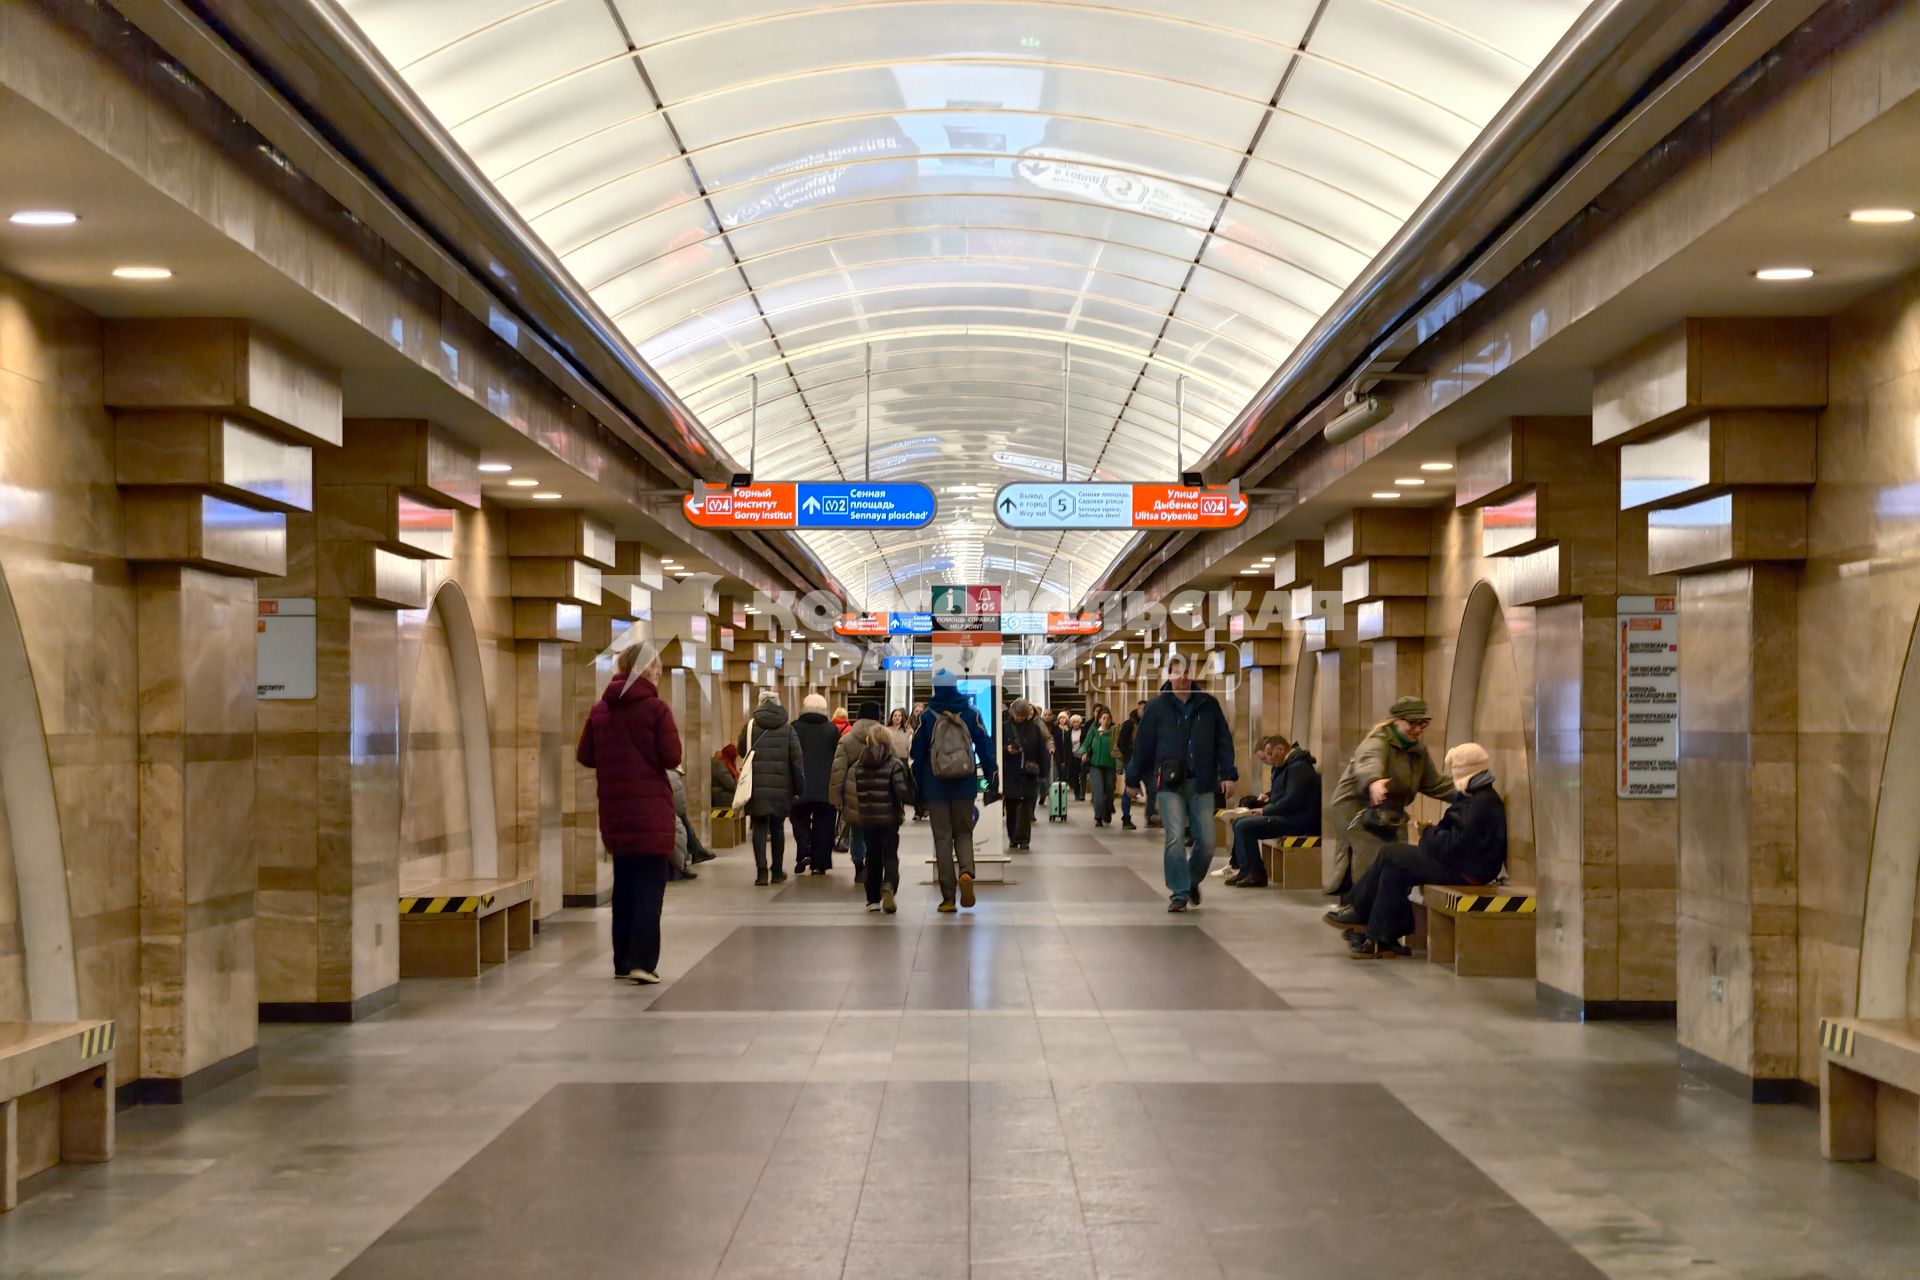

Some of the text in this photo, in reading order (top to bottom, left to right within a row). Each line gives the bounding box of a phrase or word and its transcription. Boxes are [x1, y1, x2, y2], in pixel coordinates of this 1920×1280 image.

[734, 487, 772, 499] Горный
[850, 488, 886, 498] Сенная
[1019, 492, 1044, 501] Выход
[1167, 488, 1199, 499] Улица
[734, 501, 777, 511] институт
[850, 501, 895, 511] площадь
[1026, 501, 1048, 510] город
[1057, 498, 1068, 513] 5
[1153, 500, 1199, 511] Дыбенко
[734, 511, 760, 521] Gorny
[850, 511, 887, 521] Sennaya
[1019, 510, 1034, 519] Way
[1135, 511, 1199, 522] Ulitsa Dybenko
[975, 602, 995, 611] SOS
[936, 616, 966, 624] ПОМОЩЬ
